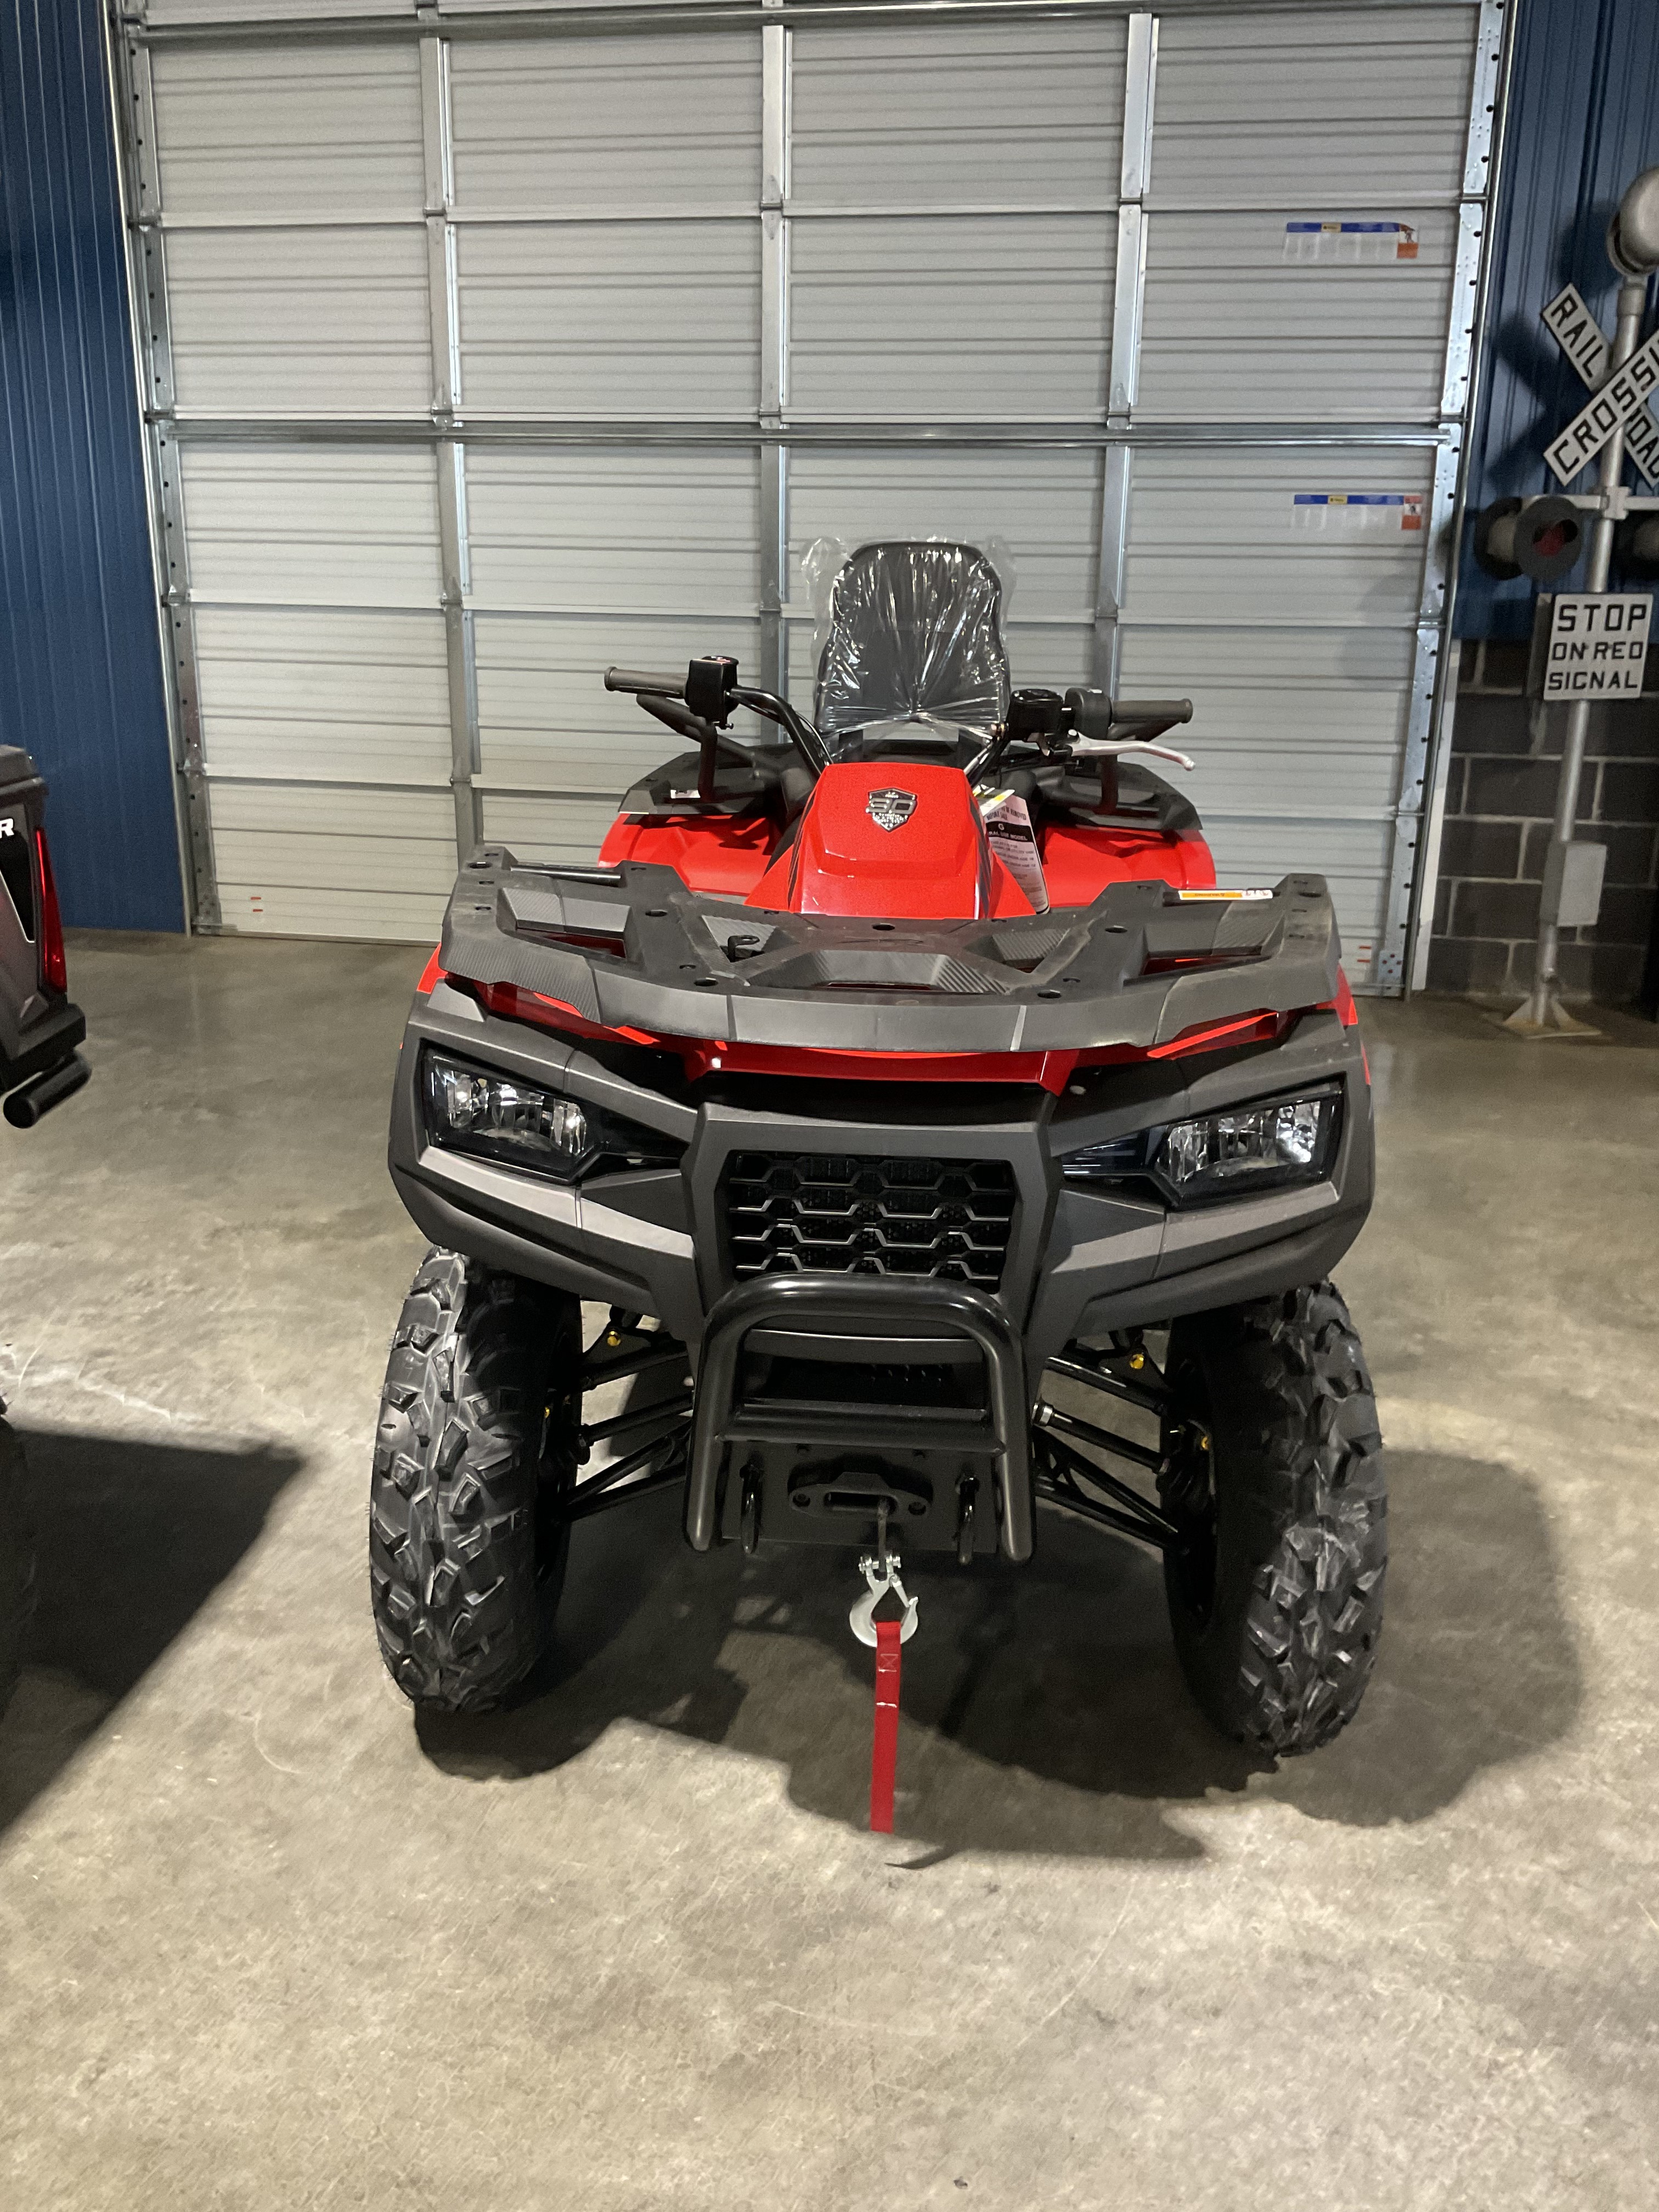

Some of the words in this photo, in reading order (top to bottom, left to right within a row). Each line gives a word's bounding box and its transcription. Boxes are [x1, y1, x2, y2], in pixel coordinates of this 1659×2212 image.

[1551, 294, 1603, 377] RAIL
[1553, 339, 1659, 474] CROSSI
[1557, 604, 1647, 631] STOP
[1551, 642, 1585, 661] ON
[1593, 641, 1644, 660] RED
[1548, 670, 1638, 691] SIGNAL
